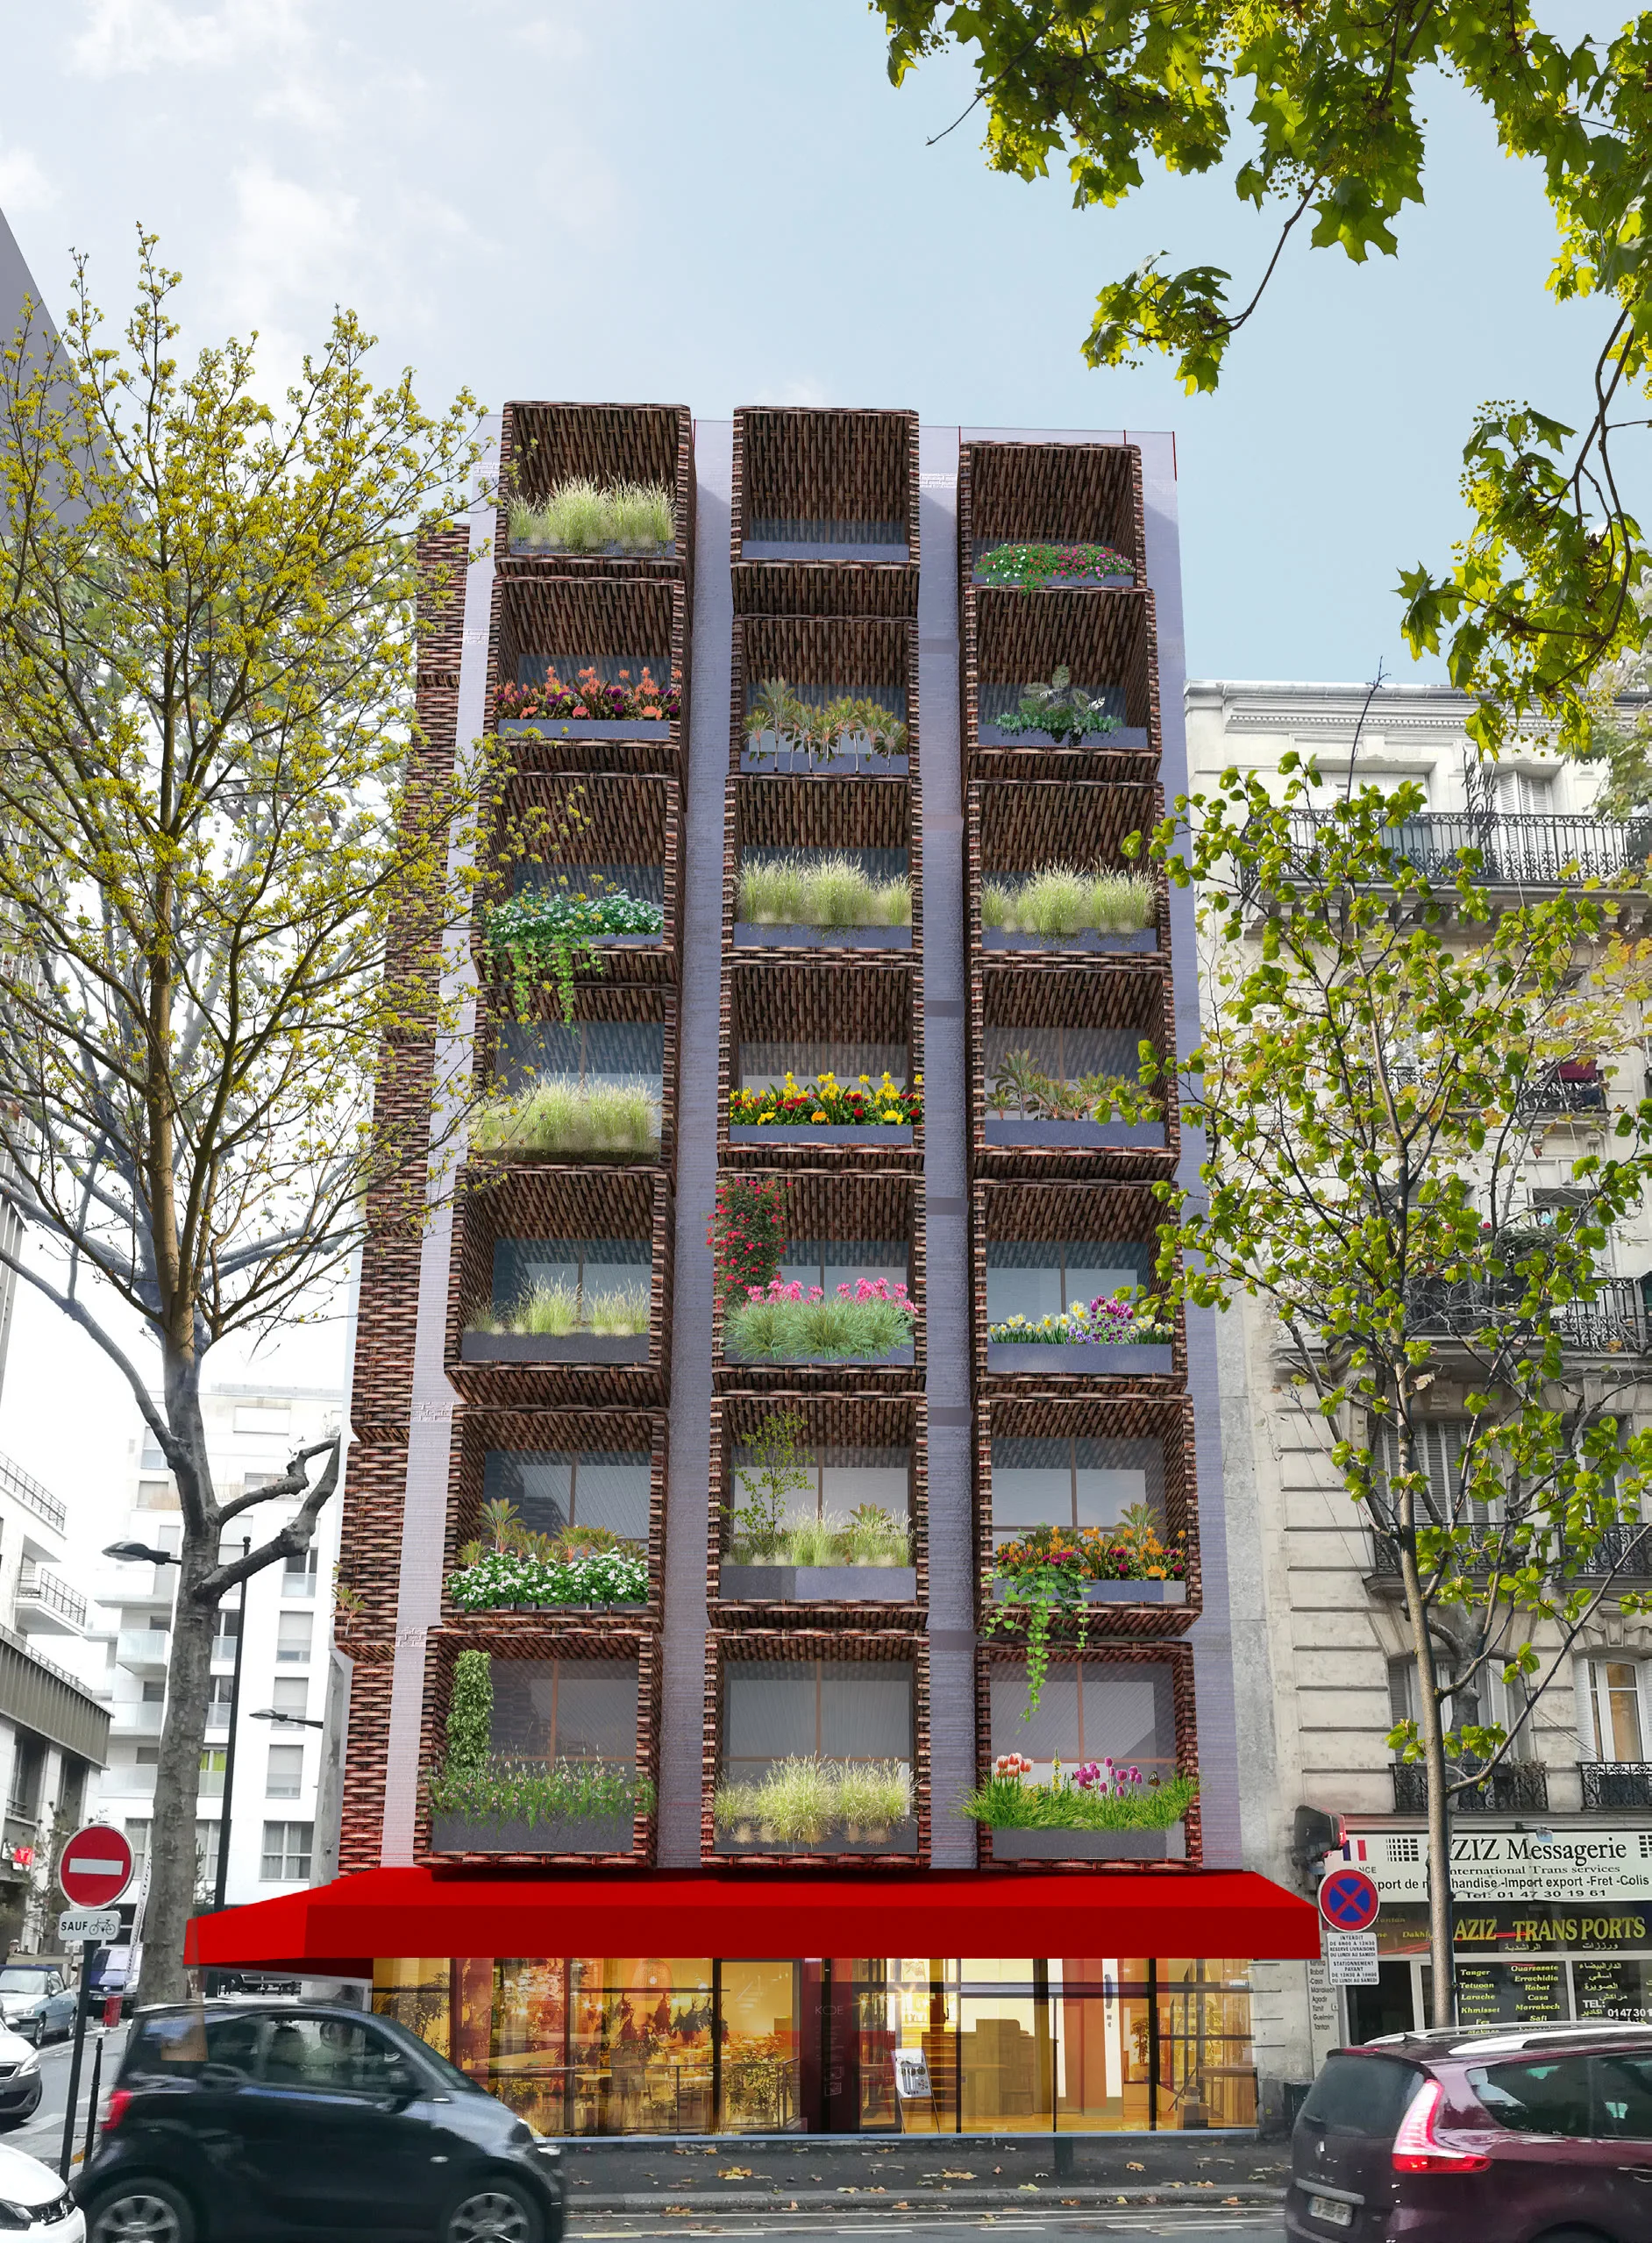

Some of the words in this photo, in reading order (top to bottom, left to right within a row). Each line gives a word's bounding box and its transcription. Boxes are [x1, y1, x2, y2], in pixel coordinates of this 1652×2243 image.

[1449, 1838, 1500, 1861] ZIZ
[1506, 1836, 1627, 1867] Messagerie
[1449, 1866, 1526, 1875] nternational
[1529, 1865, 1568, 1875] Trans
[1571, 1864, 1620, 1874] services
[1405, 1878, 1419, 1890] de
[1546, 1876, 1583, 1890] export
[61, 1921, 88, 1931] SAUF
[1453, 1919, 1498, 1941] AZIZ
[1582, 1999, 1606, 2008] TEL:
